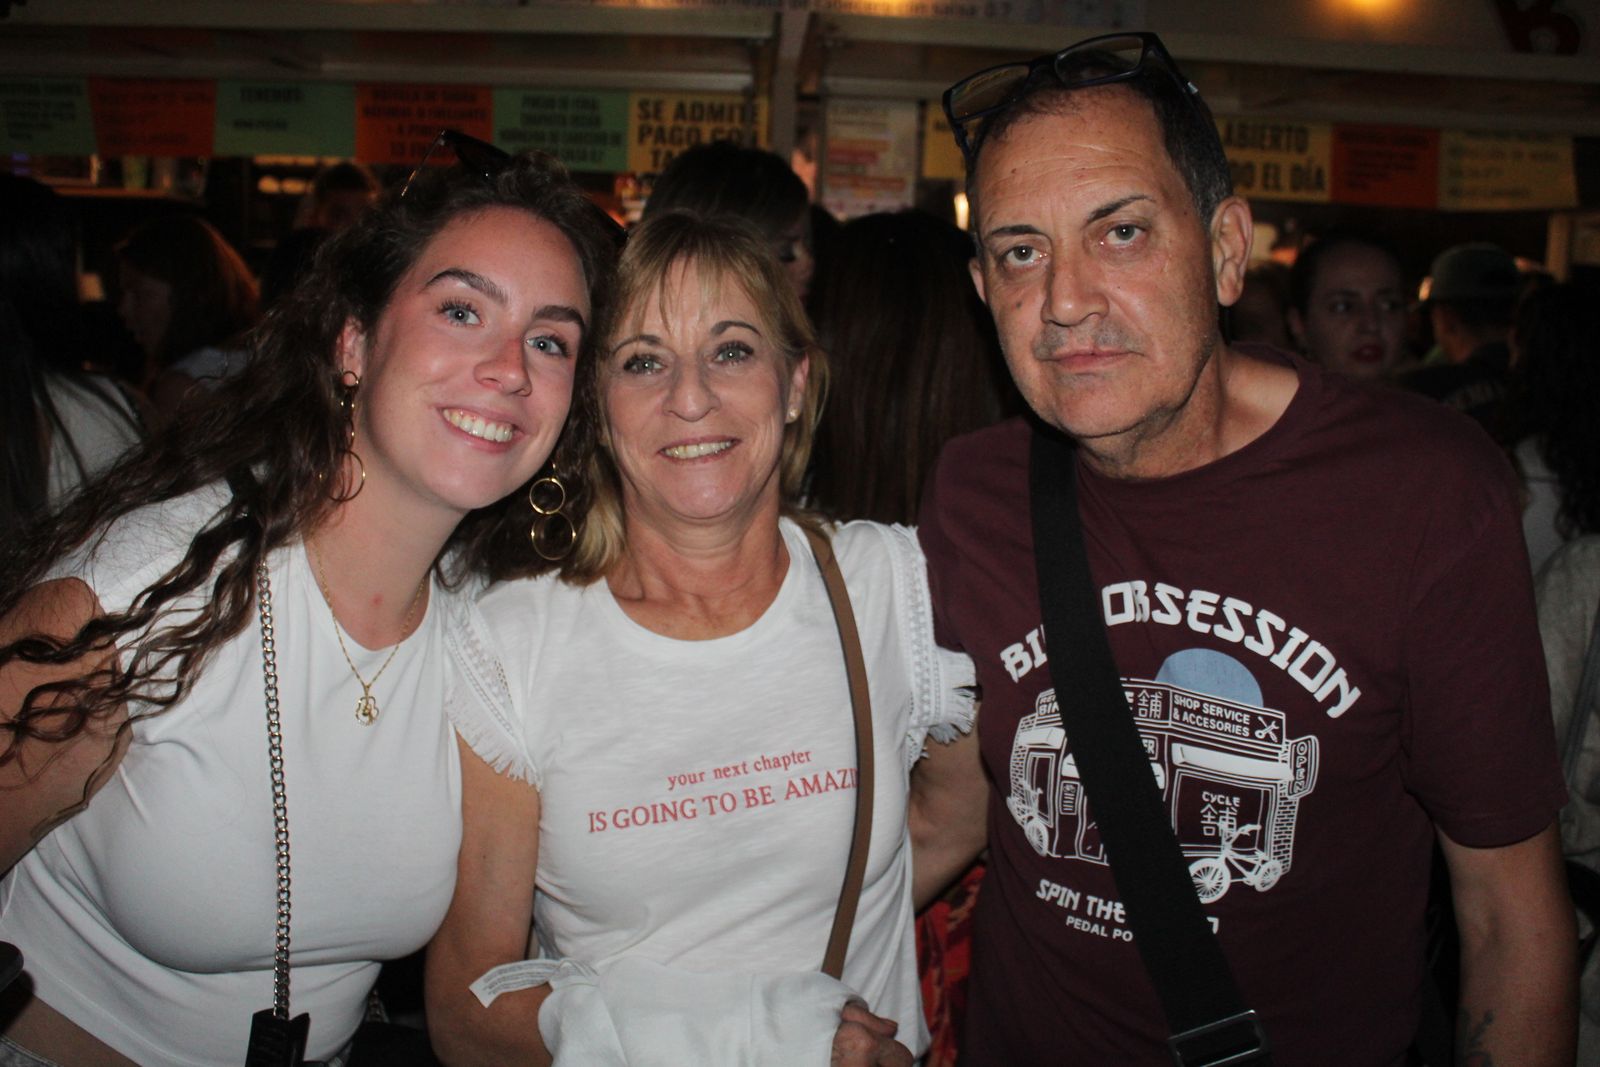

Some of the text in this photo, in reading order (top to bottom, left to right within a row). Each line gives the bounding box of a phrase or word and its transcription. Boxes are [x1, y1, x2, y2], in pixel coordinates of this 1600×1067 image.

[637, 98, 759, 124] SE ADMITE
[637, 123, 701, 144] PAGO
[1262, 162, 1282, 190] EL
[999, 623, 1048, 684] BI
[1173, 693, 1251, 726] SHOP SERVICE
[1173, 708, 1251, 738] & ACCESORIES
[667, 749, 812, 791] your next chapter
[1294, 741, 1308, 794] OPEN
[588, 810, 608, 834] IS
[611, 797, 698, 830] GOING
[702, 792, 738, 816] TO
[742, 785, 776, 809] BE
[1201, 790, 1241, 808] CYCLE
[1035, 878, 1127, 924] SPIN THE
[1065, 915, 1134, 943] PEDAL PO
